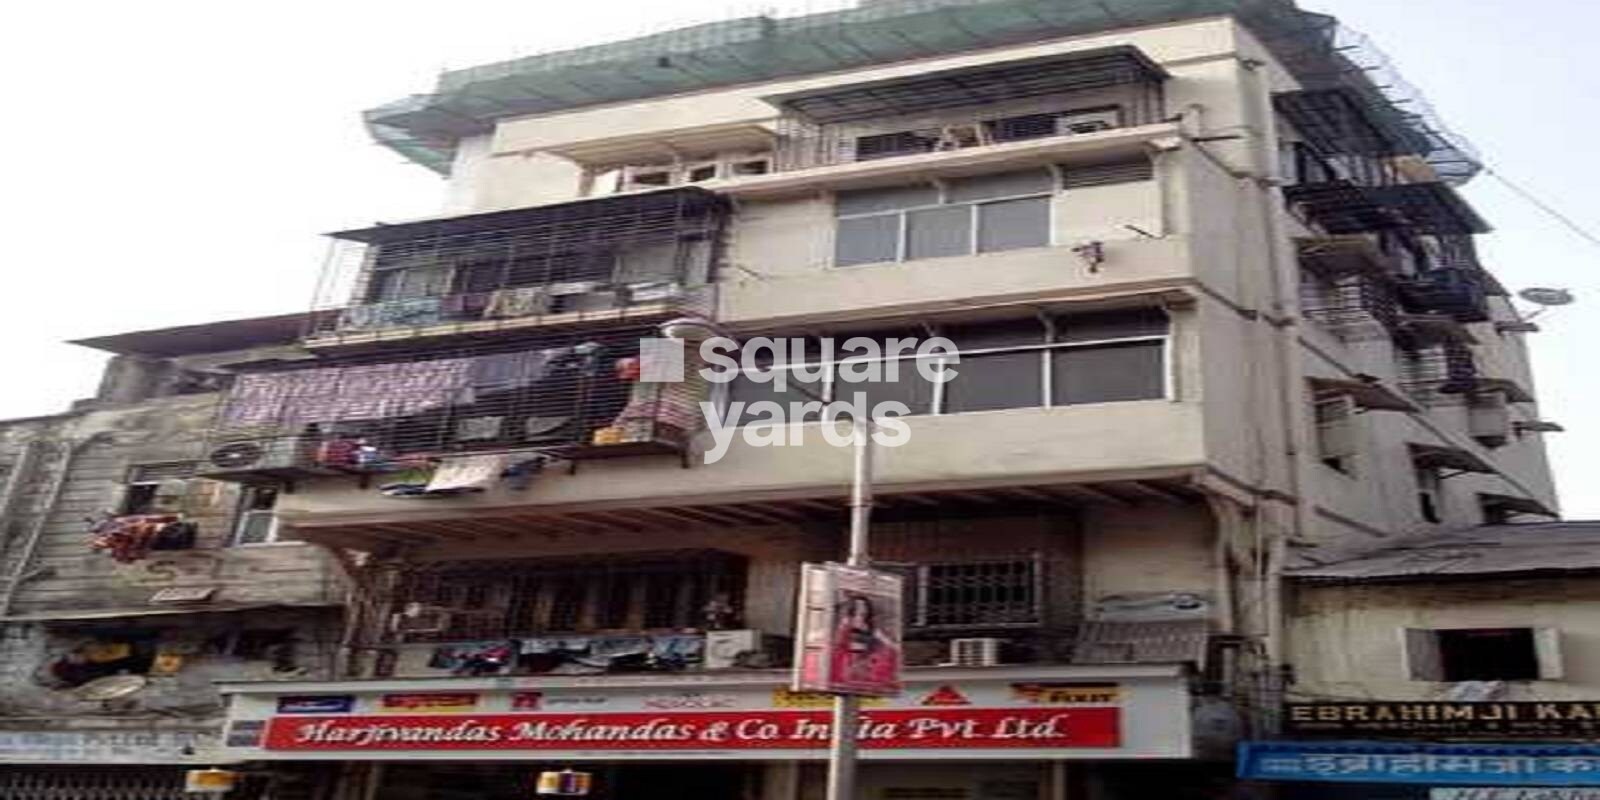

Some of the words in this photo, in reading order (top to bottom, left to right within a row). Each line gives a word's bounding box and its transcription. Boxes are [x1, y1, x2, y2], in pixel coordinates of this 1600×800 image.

[1292, 703, 1518, 721] EBRAHIMJI
[297, 719, 503, 745] Harjivandas
[509, 718, 696, 740] Mohandas
[699, 721, 729, 741] &
[736, 719, 780, 740] Co
[790, 716, 900, 739] Inia
